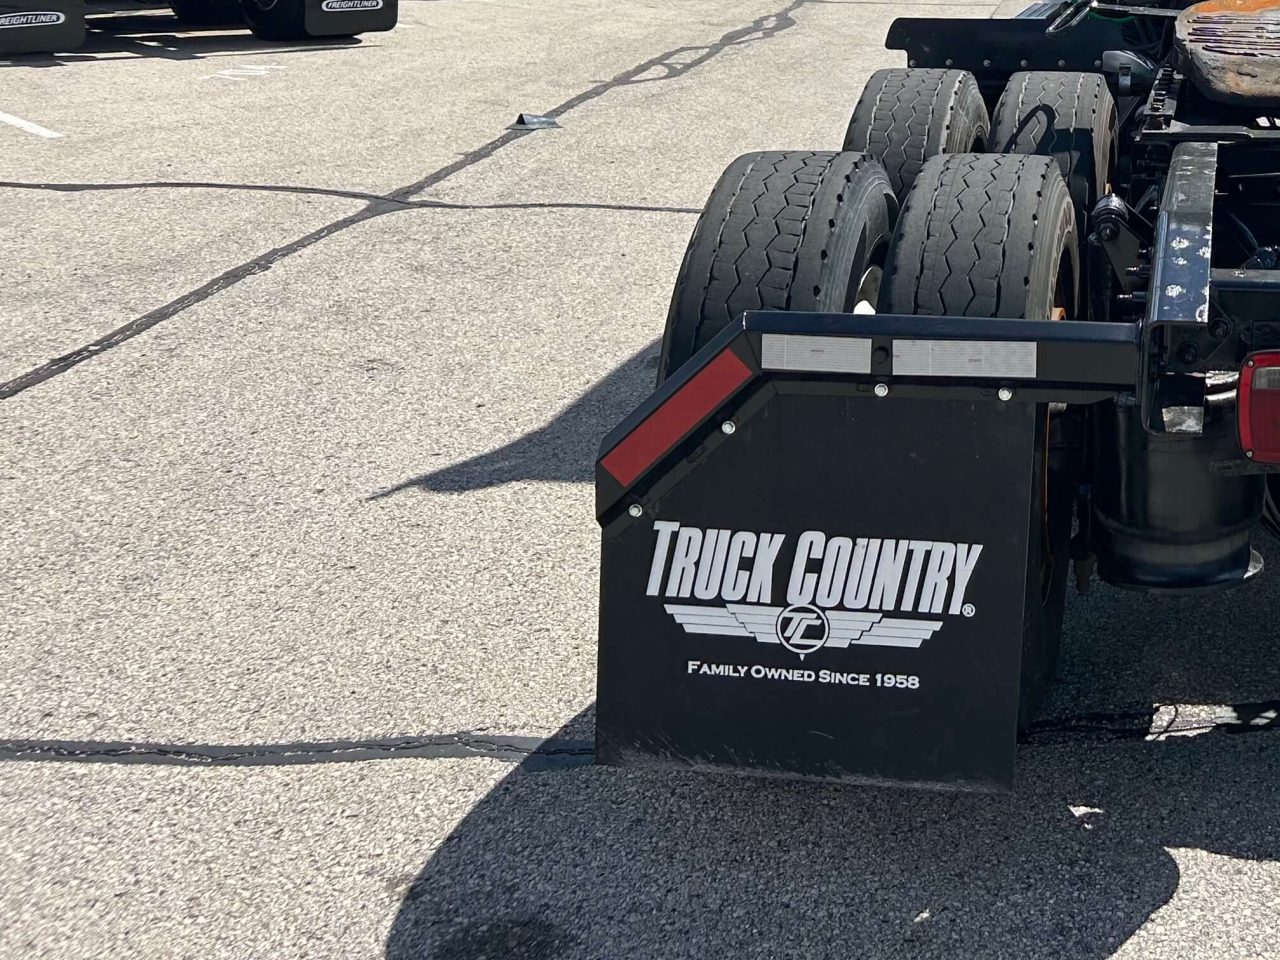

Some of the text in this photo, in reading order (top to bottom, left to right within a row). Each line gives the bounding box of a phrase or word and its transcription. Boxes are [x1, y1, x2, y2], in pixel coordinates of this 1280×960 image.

[327, 0, 378, 9] FREIGHTLINER
[0, 14, 58, 25] REIGHTLINER
[646, 520, 984, 615] TRUCK COUNTRY
[687, 660, 920, 690] FAMILY OWNED SINCE 1958
